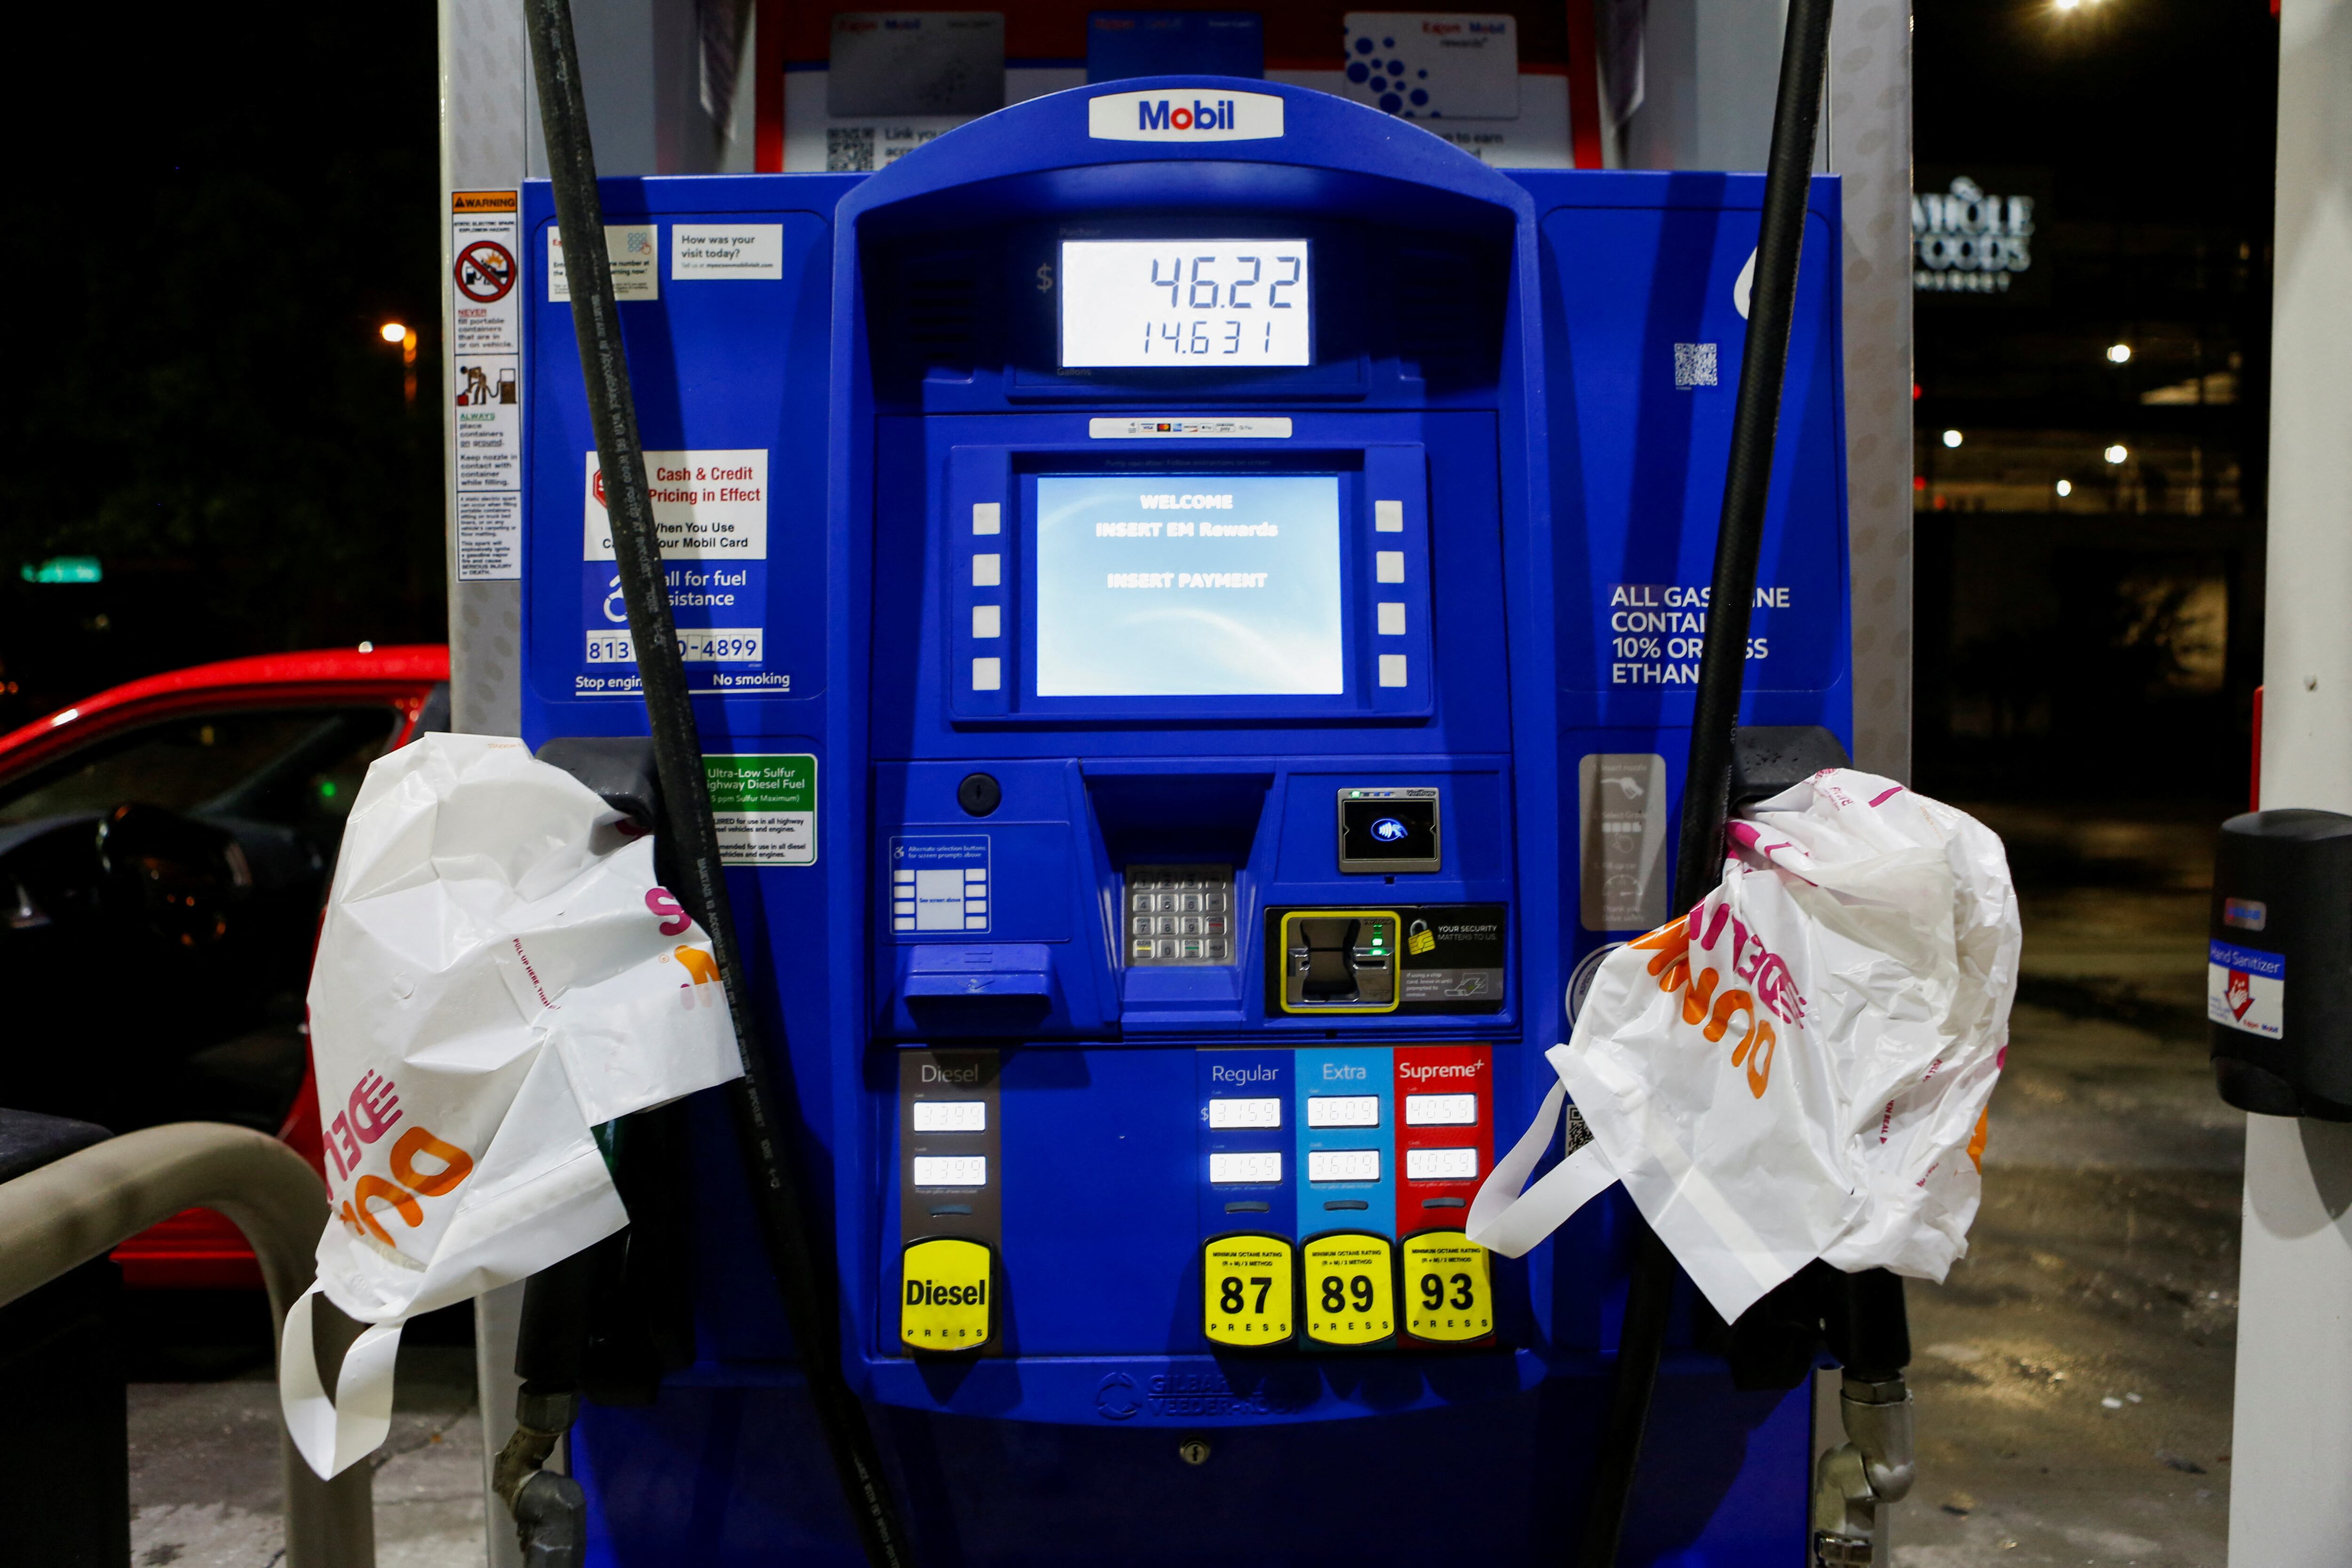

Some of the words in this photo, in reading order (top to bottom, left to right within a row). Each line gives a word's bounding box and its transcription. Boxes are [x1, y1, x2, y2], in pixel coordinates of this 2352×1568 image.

[1139, 100, 1233, 130] Mobil
[465, 198, 515, 208] WARNING
[731, 237, 755, 246] your
[682, 249, 703, 257] visit
[706, 249, 740, 260] today?
[1036, 263, 1053, 293] $
[1151, 256, 1301, 309] 46.22
[1144, 320, 1271, 354] 14.631
[657, 467, 691, 481] Cash
[696, 468, 706, 481] &
[711, 467, 753, 480] Credit
[649, 488, 698, 505] Pricing
[702, 488, 715, 502] in
[720, 487, 761, 502] Effect
[1140, 494, 1233, 510] WELCOME
[685, 523, 707, 532] You
[712, 522, 735, 532] Use
[1096, 522, 1162, 537] INSERT
[1167, 522, 1194, 537] EM
[1200, 522, 1278, 537] Rewards
[683, 538, 715, 548] Mobil
[720, 537, 748, 548] Card
[664, 571, 680, 586] all
[684, 570, 709, 586] for
[713, 570, 747, 586] fuel
[1107, 572, 1174, 588] INSERT
[1178, 572, 1268, 588] PAYMENT
[668, 591, 735, 607] sistance
[1611, 586, 1658, 607] ALL
[1664, 586, 1790, 608] GASNE
[1611, 612, 1706, 633] CONTAI
[1613, 637, 1661, 658] 10%
[1667, 638, 1702, 658] OR
[575, 676, 605, 690] Stop
[607, 675, 643, 689] engin
[713, 673, 732, 686] No
[735, 672, 790, 689] smoking
[1613, 663, 1699, 683] ETHAN
[708, 768, 761, 778] Ultra-Low
[763, 767, 796, 778] Sulfur
[707, 779, 745, 792] ighway
[747, 779, 780, 789] Diesel
[783, 778, 805, 789] Fuel
[760, 794, 800, 803] Maximum)
[2232, 951, 2280, 974] Sanitizer
[921, 1064, 979, 1083] Diesel
[1212, 1065, 1279, 1086] Regular
[1322, 1063, 1367, 1080] Extra
[1200, 1107, 1209, 1121] $
[906, 1279, 985, 1305] Diesel
[1220, 1276, 1272, 1314] 87
[1321, 1275, 1374, 1313] 89
[1420, 1273, 1474, 1311] 93
[1211, 1323, 1286, 1331] PRESS
[1313, 1322, 1388, 1330] PRESS
[1413, 1319, 1487, 1328] PRESS
